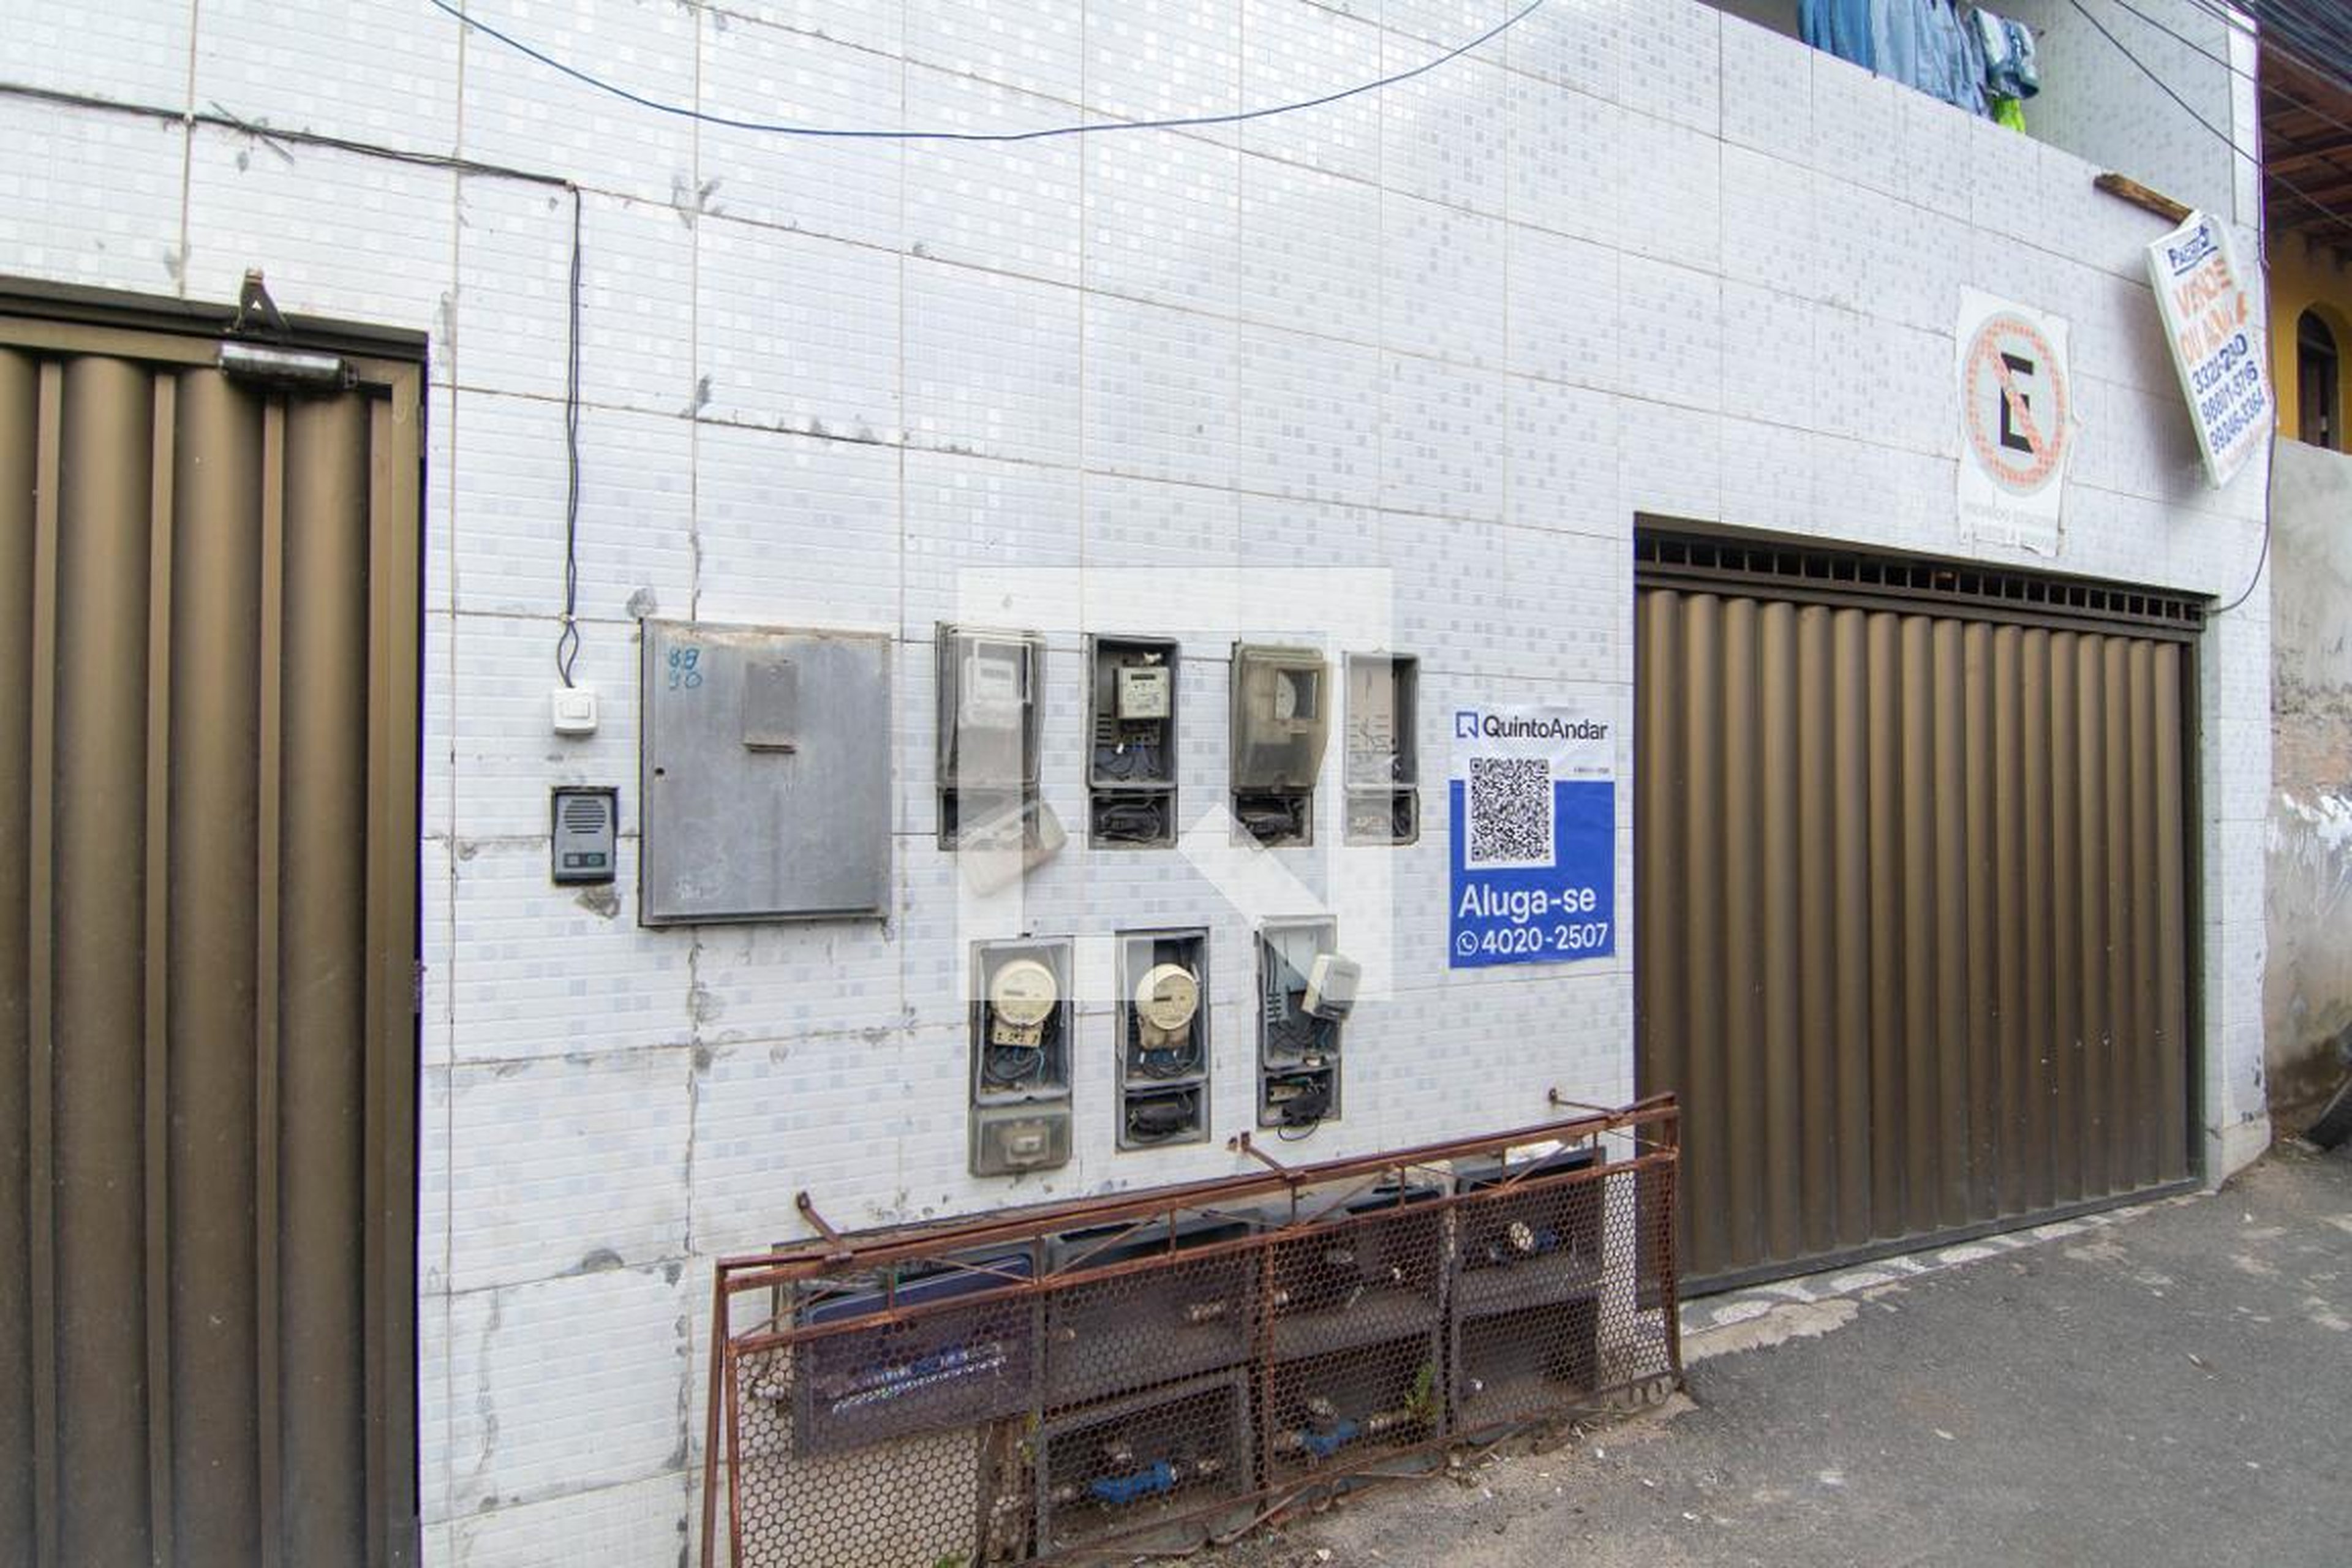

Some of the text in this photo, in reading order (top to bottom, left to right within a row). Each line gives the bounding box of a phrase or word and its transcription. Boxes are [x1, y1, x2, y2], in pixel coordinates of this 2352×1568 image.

[1482, 715, 1608, 741] QuintoAndar
[1457, 883, 1596, 924] Aluga-se
[1481, 923, 1608, 954] 4020-2507
